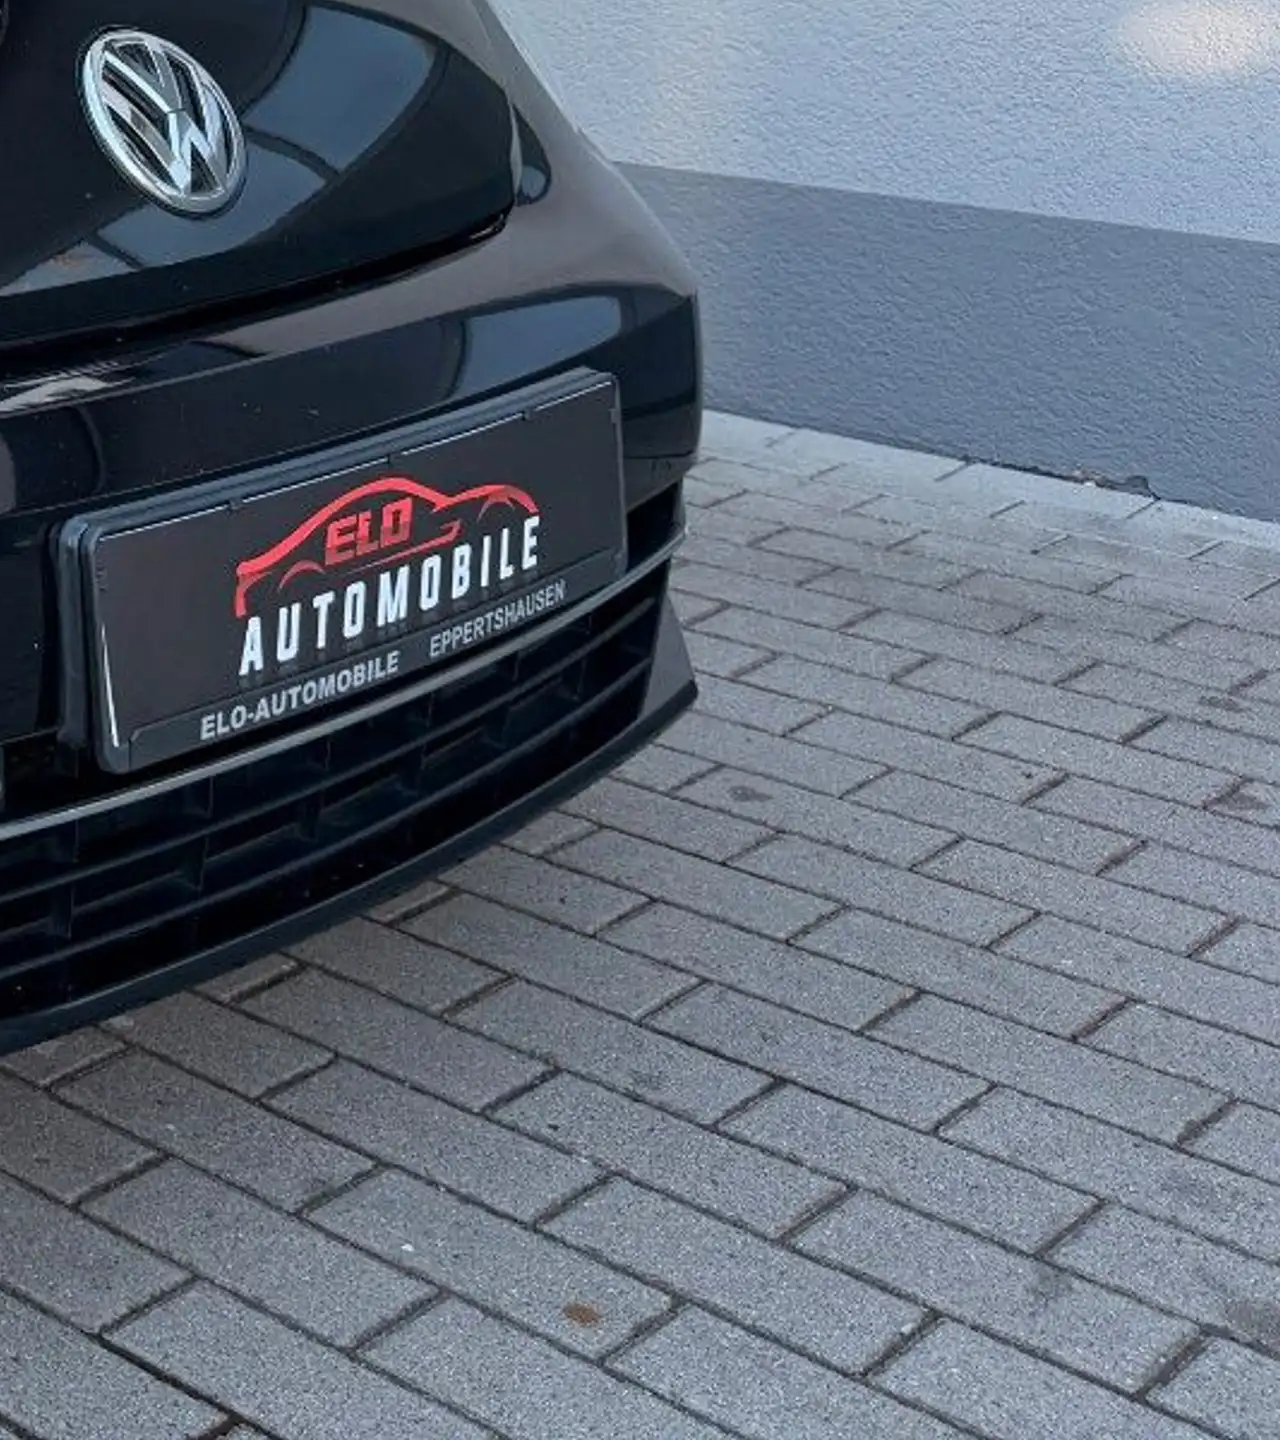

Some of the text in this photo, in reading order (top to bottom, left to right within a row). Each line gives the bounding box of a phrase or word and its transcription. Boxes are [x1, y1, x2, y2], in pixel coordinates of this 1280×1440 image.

[239, 515, 541, 677] AUTOMOBILE
[324, 498, 414, 566] ELO
[199, 579, 567, 742] ELO-AUTOMOBILE EPPERTSHAUSEN
